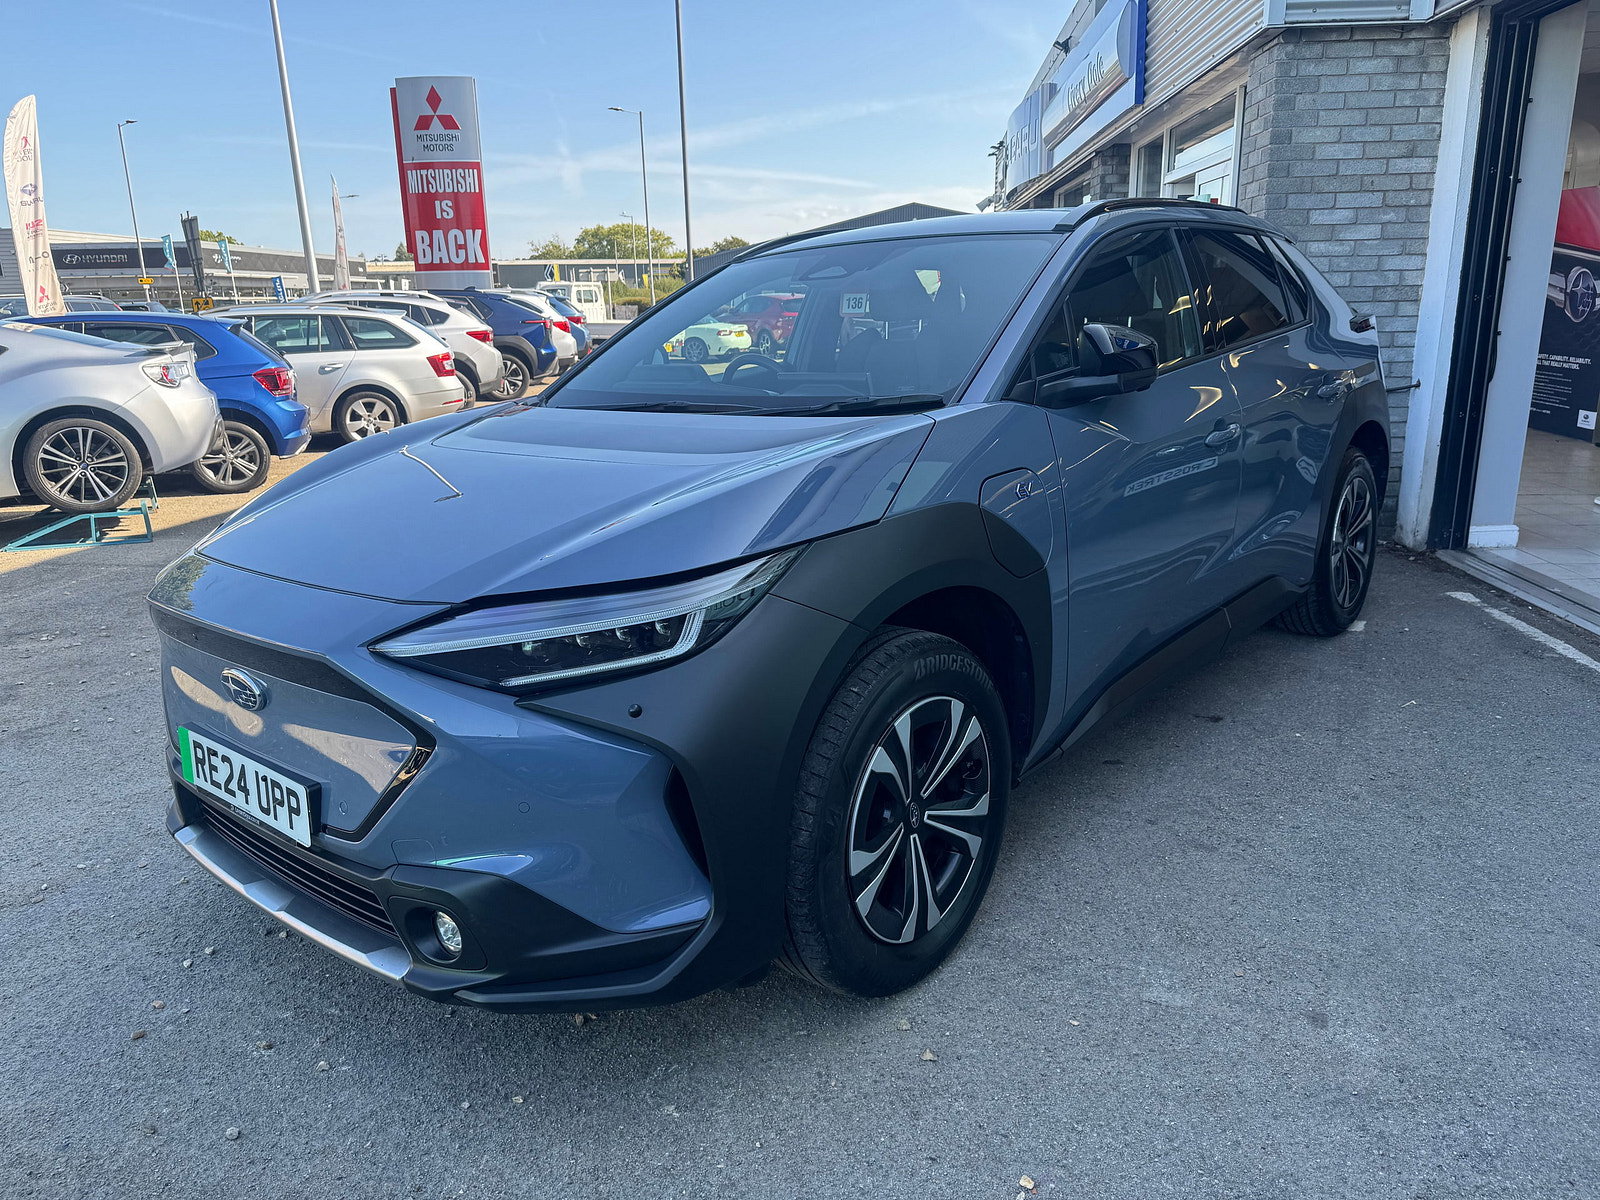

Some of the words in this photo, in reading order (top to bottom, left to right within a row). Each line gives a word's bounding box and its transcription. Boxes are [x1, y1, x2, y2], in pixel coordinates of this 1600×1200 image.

[416, 133, 460, 142] MITSUBISHI
[423, 144, 454, 152] MOTORS
[407, 168, 479, 194] MITSUBISHI
[435, 200, 454, 219] IS
[415, 228, 485, 265] BACK
[81, 254, 128, 263] HYUNDAI
[846, 296, 863, 310] 136
[193, 739, 250, 805] RE24
[254, 770, 301, 830] UPP
